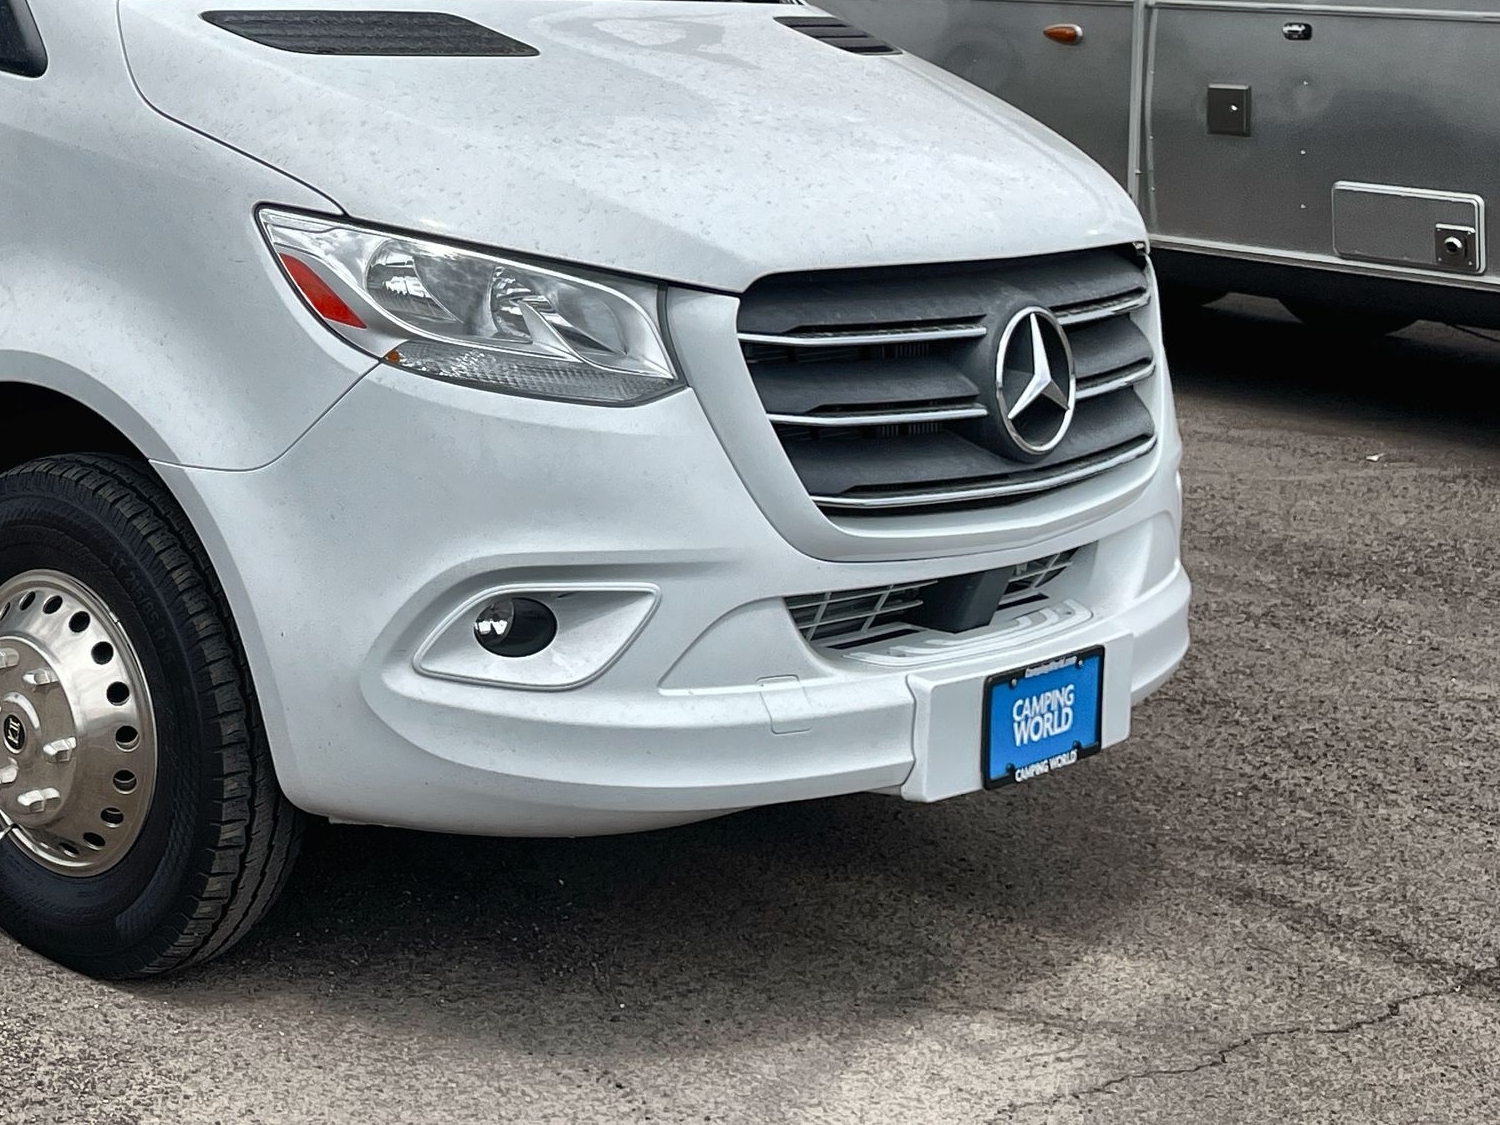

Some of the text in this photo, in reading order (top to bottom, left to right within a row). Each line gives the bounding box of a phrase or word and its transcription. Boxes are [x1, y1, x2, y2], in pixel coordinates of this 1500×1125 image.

[1012, 683, 1075, 722] CAMPING
[1013, 707, 1074, 748] WORLD
[1014, 749, 1078, 783] CAMPING WORLD
